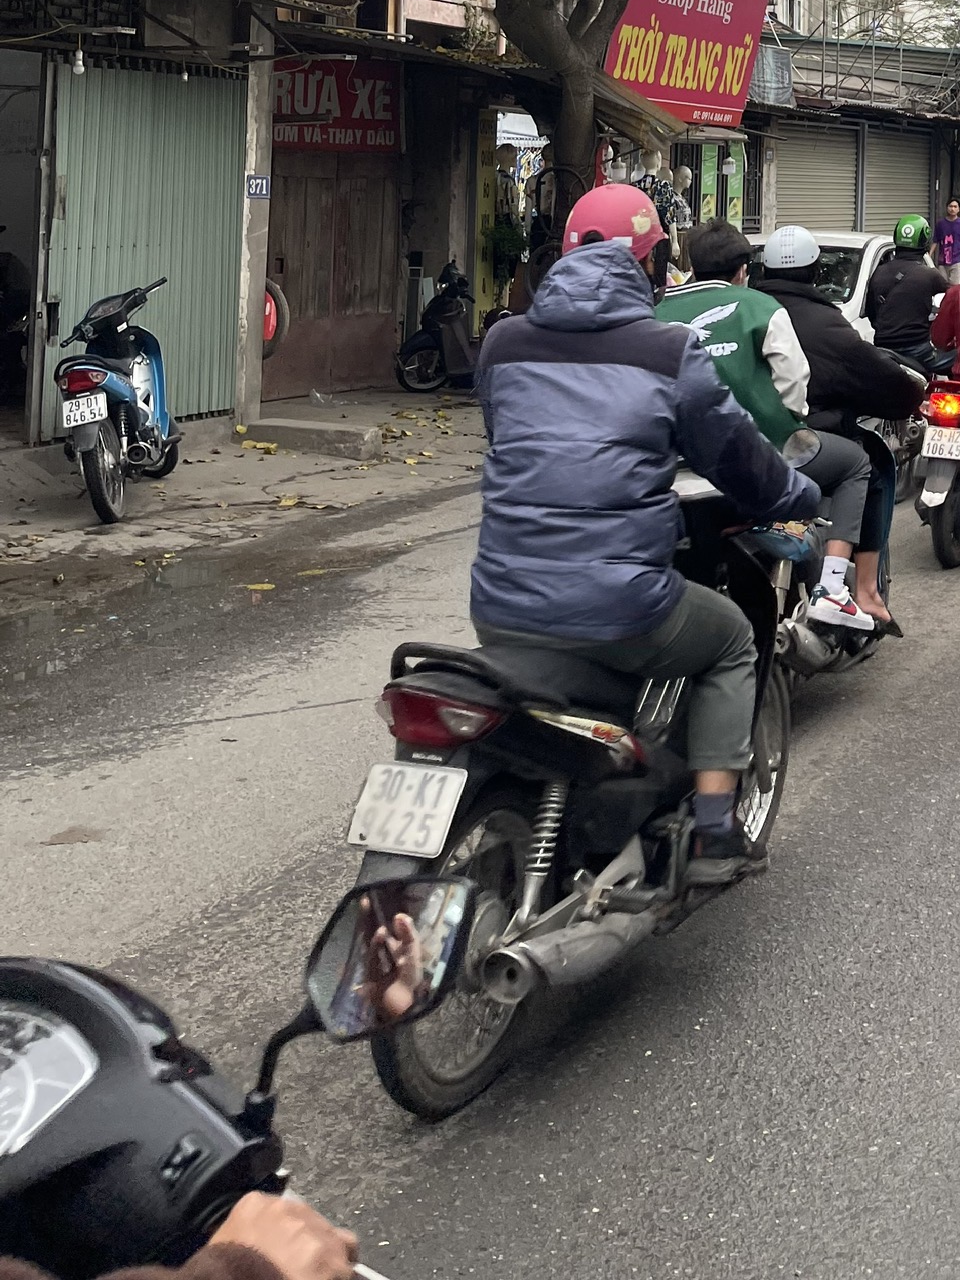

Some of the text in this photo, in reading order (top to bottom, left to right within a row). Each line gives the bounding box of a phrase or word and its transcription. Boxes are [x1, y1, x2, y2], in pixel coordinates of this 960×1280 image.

[613, 13, 754, 96] THỜI TRANG NỮ
[352, 78, 393, 120] XE
[274, 123, 298, 143] ƠM
[249, 179, 268, 194] 371
[65, 407, 103, 426] 846.54
[926, 442, 960, 457] 106.45
[371, 767, 449, 809] 30-K1
